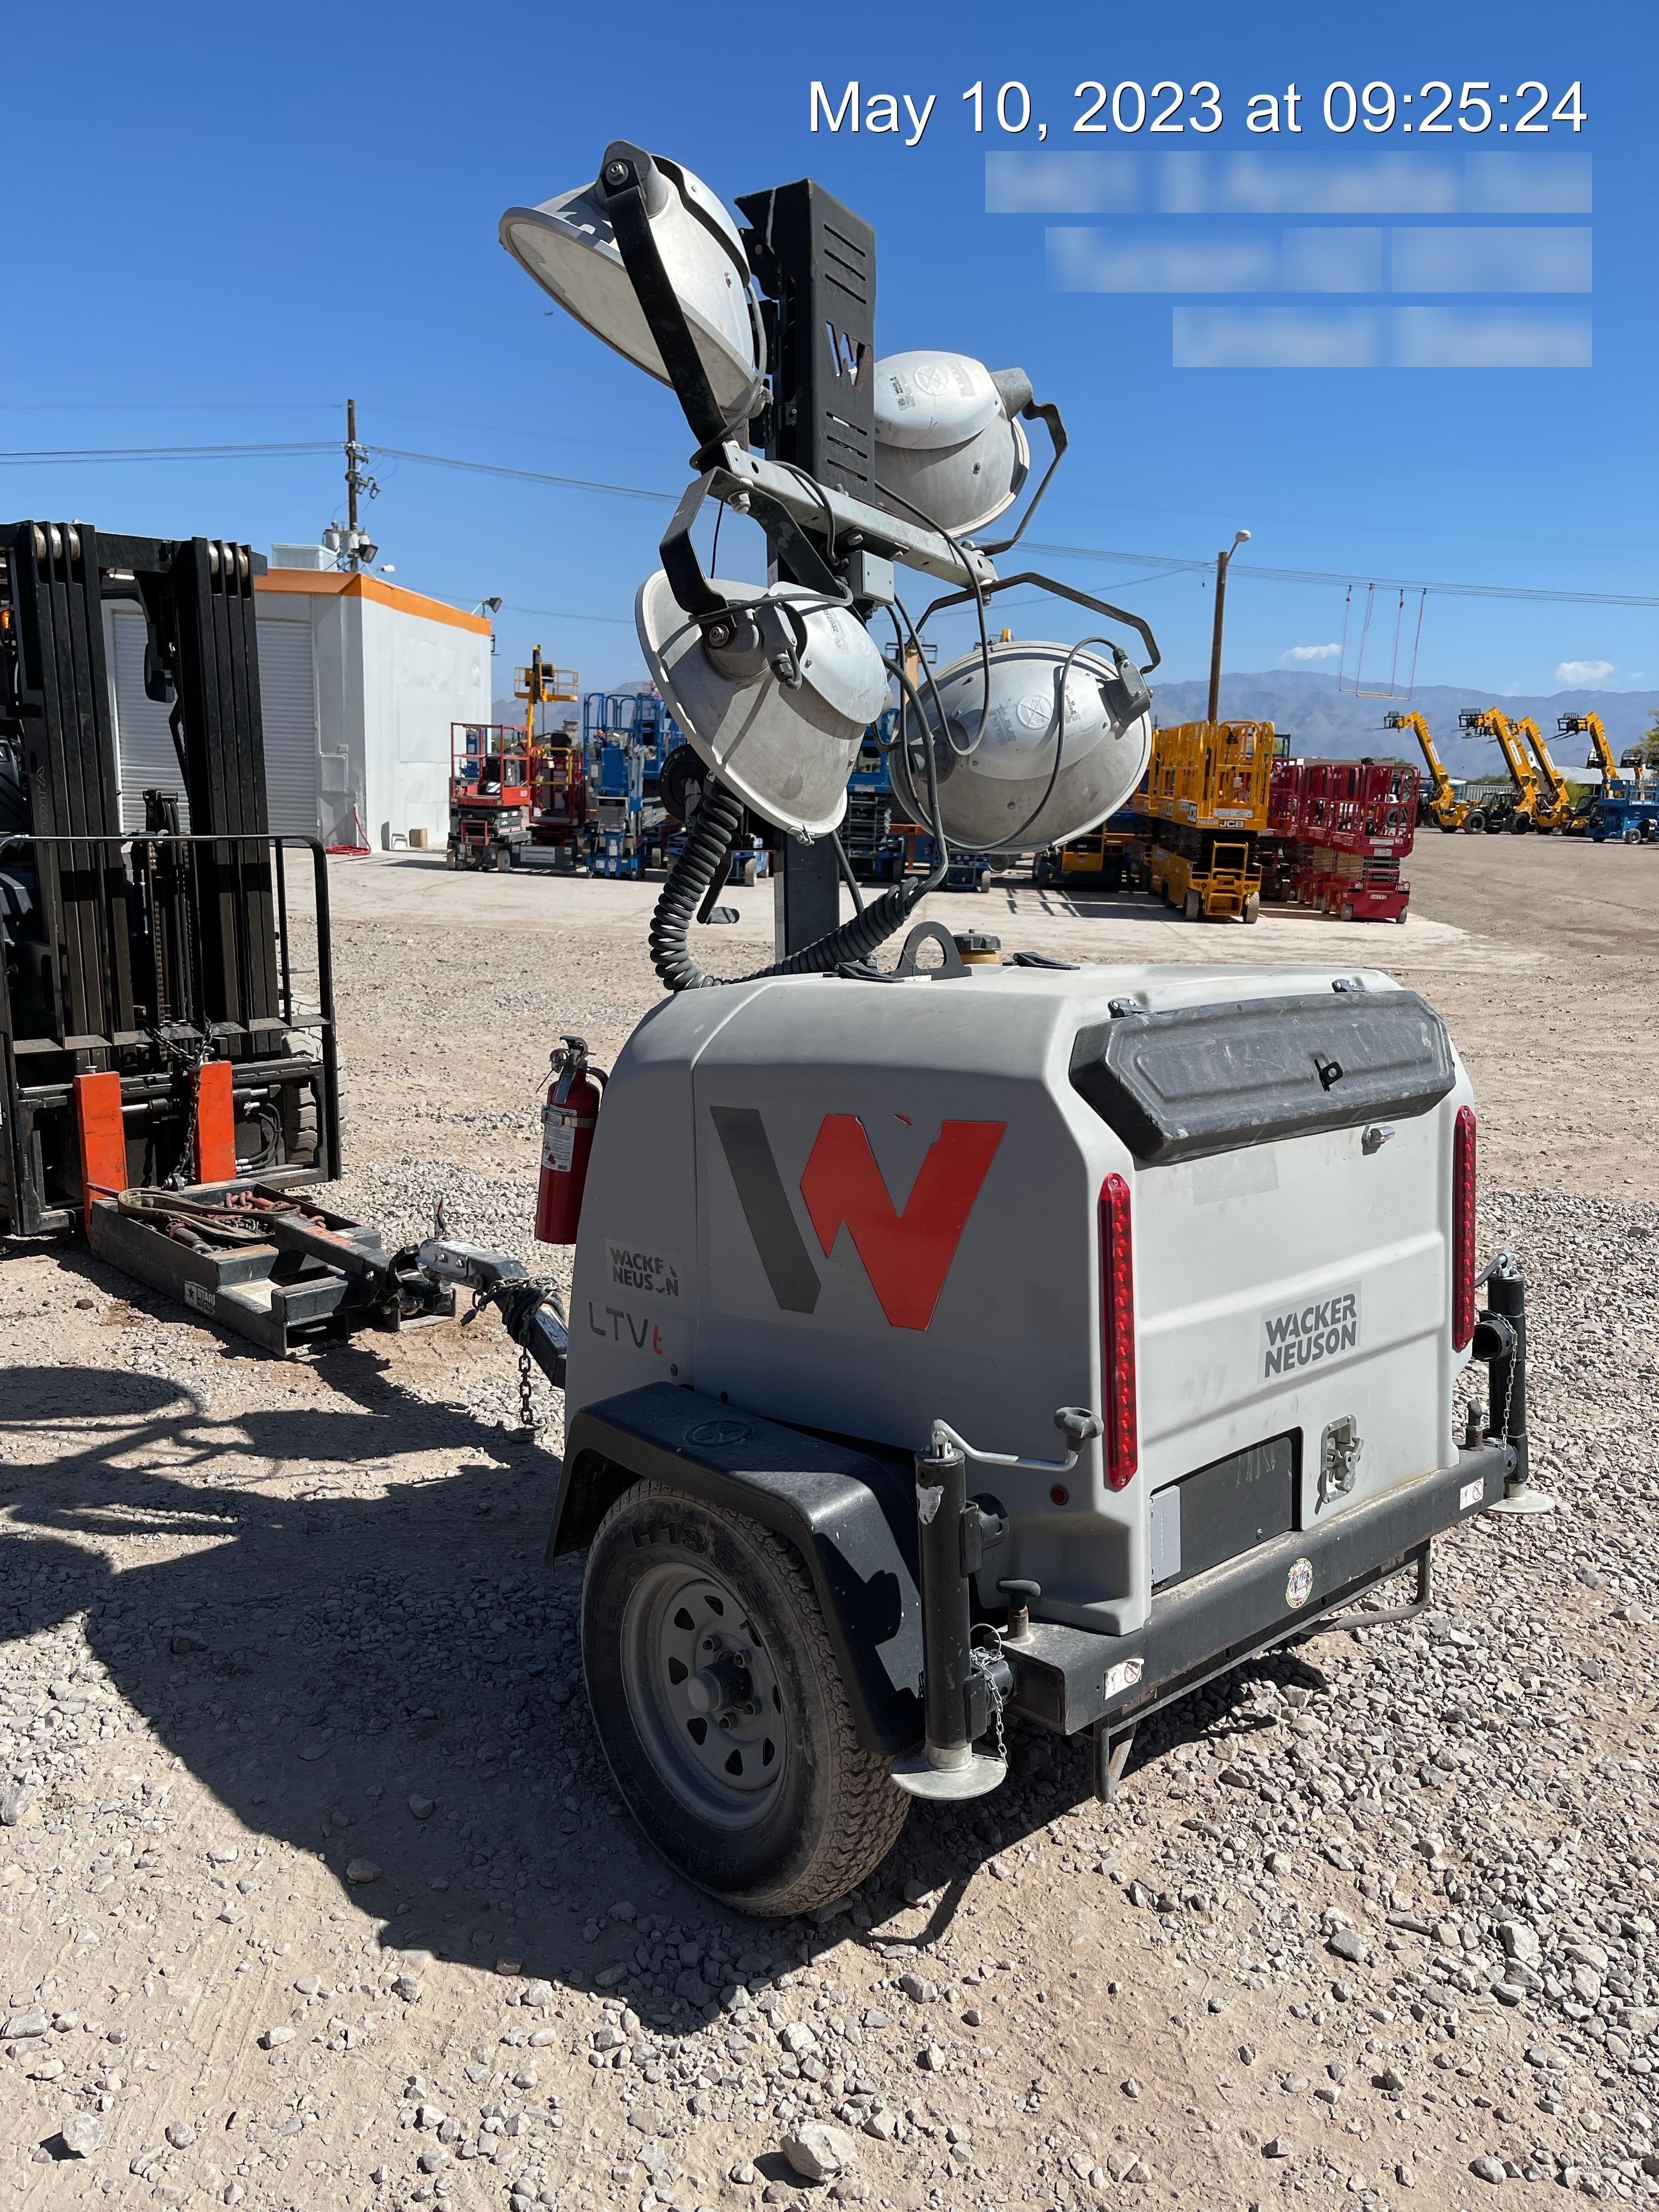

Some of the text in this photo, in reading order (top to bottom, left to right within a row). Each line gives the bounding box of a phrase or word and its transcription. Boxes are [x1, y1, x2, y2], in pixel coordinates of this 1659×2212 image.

[610, 1246, 678, 1278] WACKE
[612, 1265, 679, 1297] NEUSN
[1265, 1293, 1357, 1346] WACKER
[1265, 1321, 1357, 1378] NEUSON
